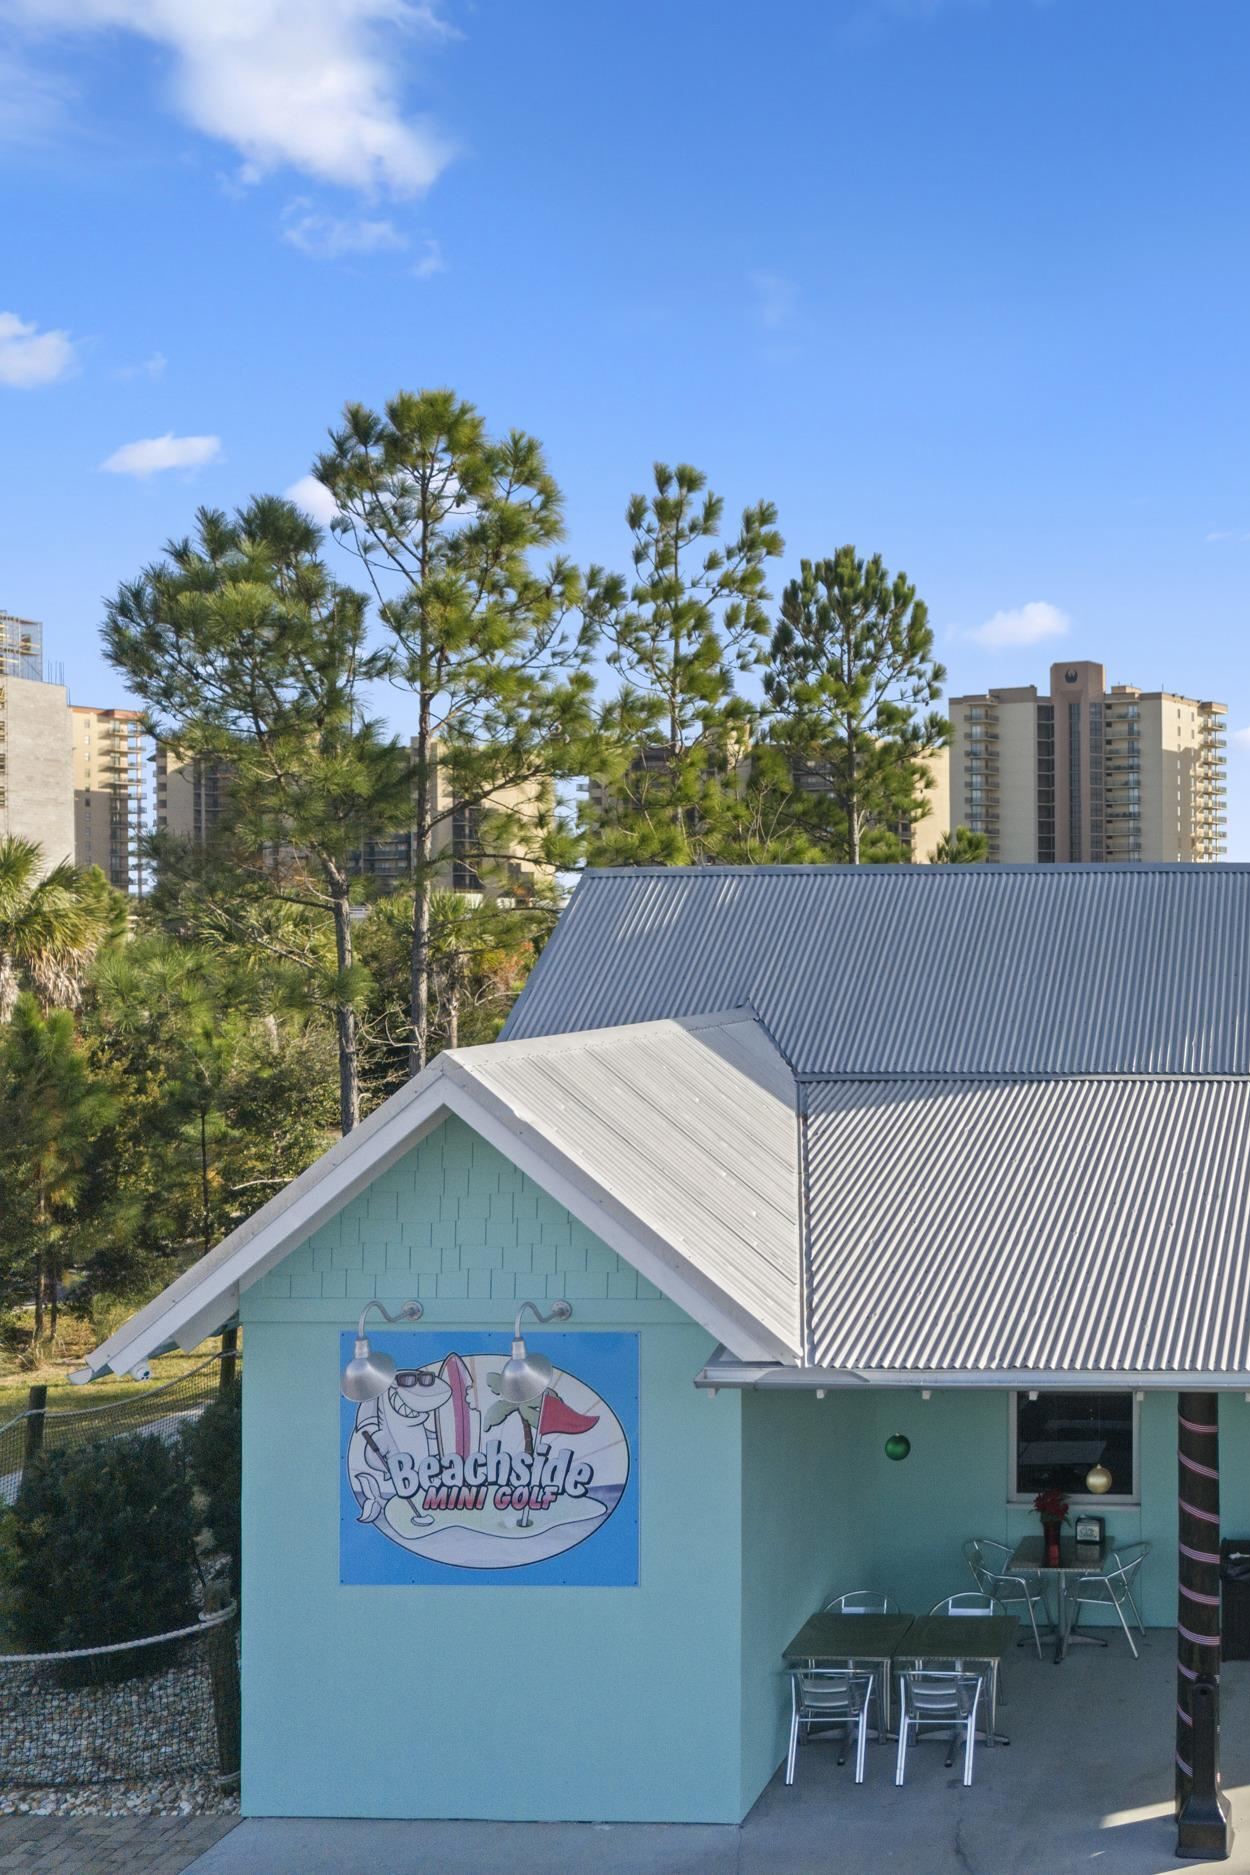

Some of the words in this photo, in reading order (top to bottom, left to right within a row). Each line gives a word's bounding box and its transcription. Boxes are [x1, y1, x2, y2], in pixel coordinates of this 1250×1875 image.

[388, 1440, 594, 1498] Beachside
[423, 1486, 488, 1511] MINI
[493, 1485, 558, 1511] GOLF
